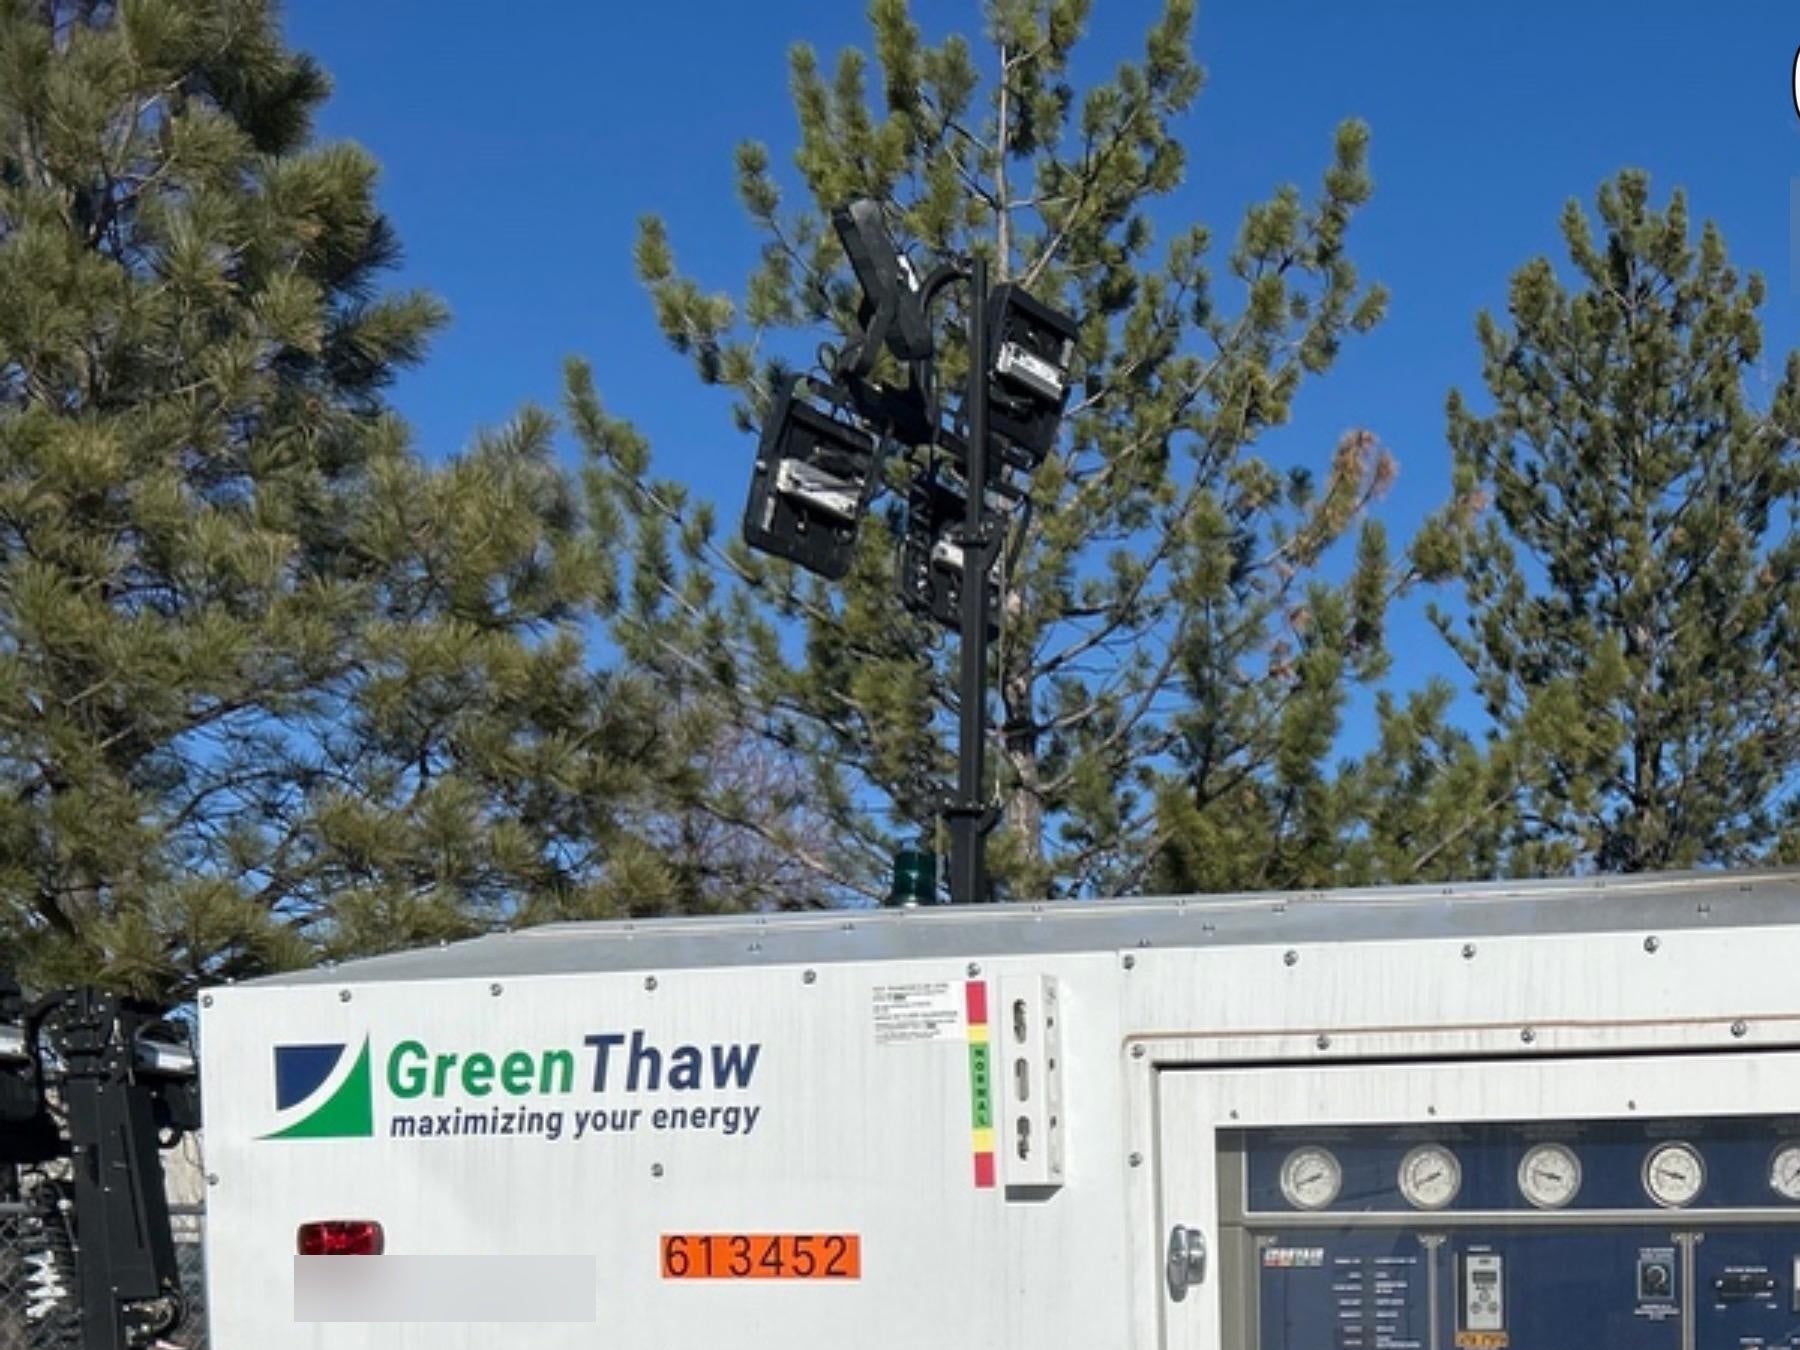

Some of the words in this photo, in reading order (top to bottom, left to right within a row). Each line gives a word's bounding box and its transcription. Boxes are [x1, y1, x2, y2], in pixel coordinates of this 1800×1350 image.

[974, 1048, 988, 1126] NORMAL
[390, 1106, 563, 1141] maximizing
[574, 1109, 642, 1139] your
[652, 1105, 760, 1135] energy
[665, 1235, 847, 1277] 613452
